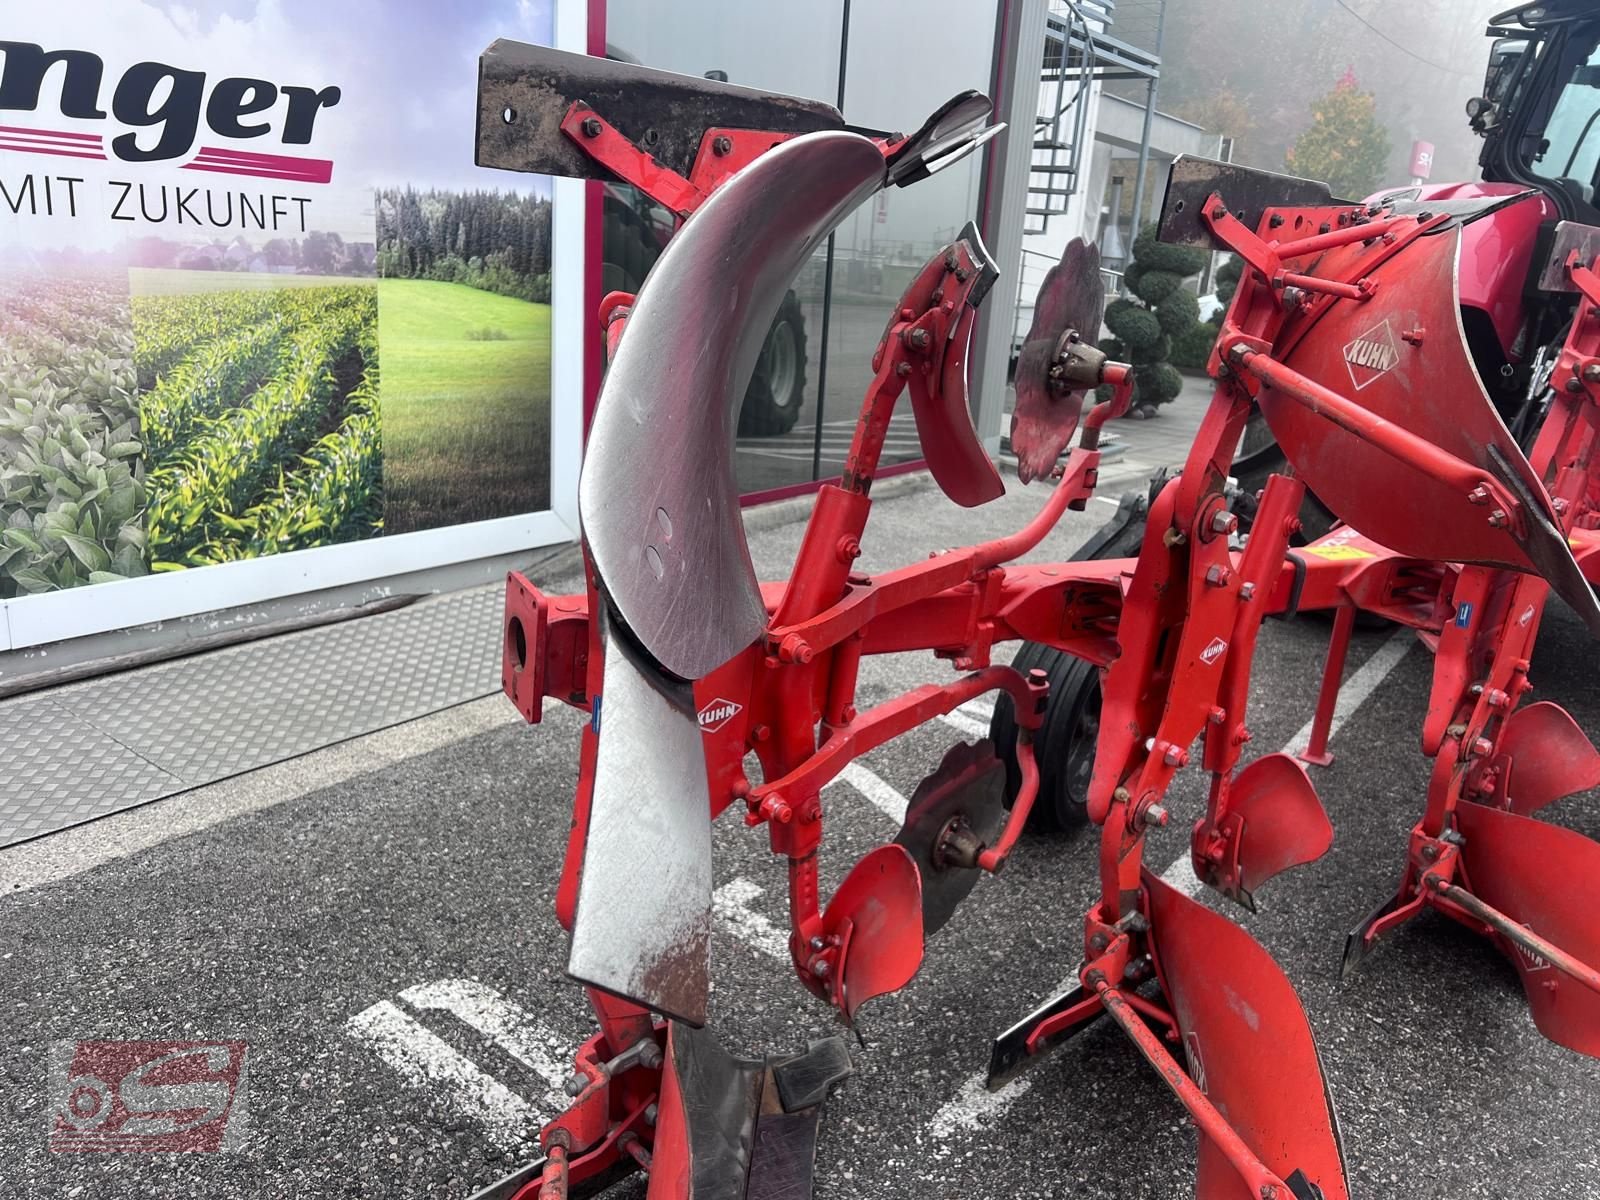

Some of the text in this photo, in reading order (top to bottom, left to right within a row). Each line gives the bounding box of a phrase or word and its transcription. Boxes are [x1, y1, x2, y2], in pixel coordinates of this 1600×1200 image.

[0, 40, 341, 162] nger
[108, 180, 312, 233] ZUKUNFT
[1347, 339, 1394, 371] KUHN
